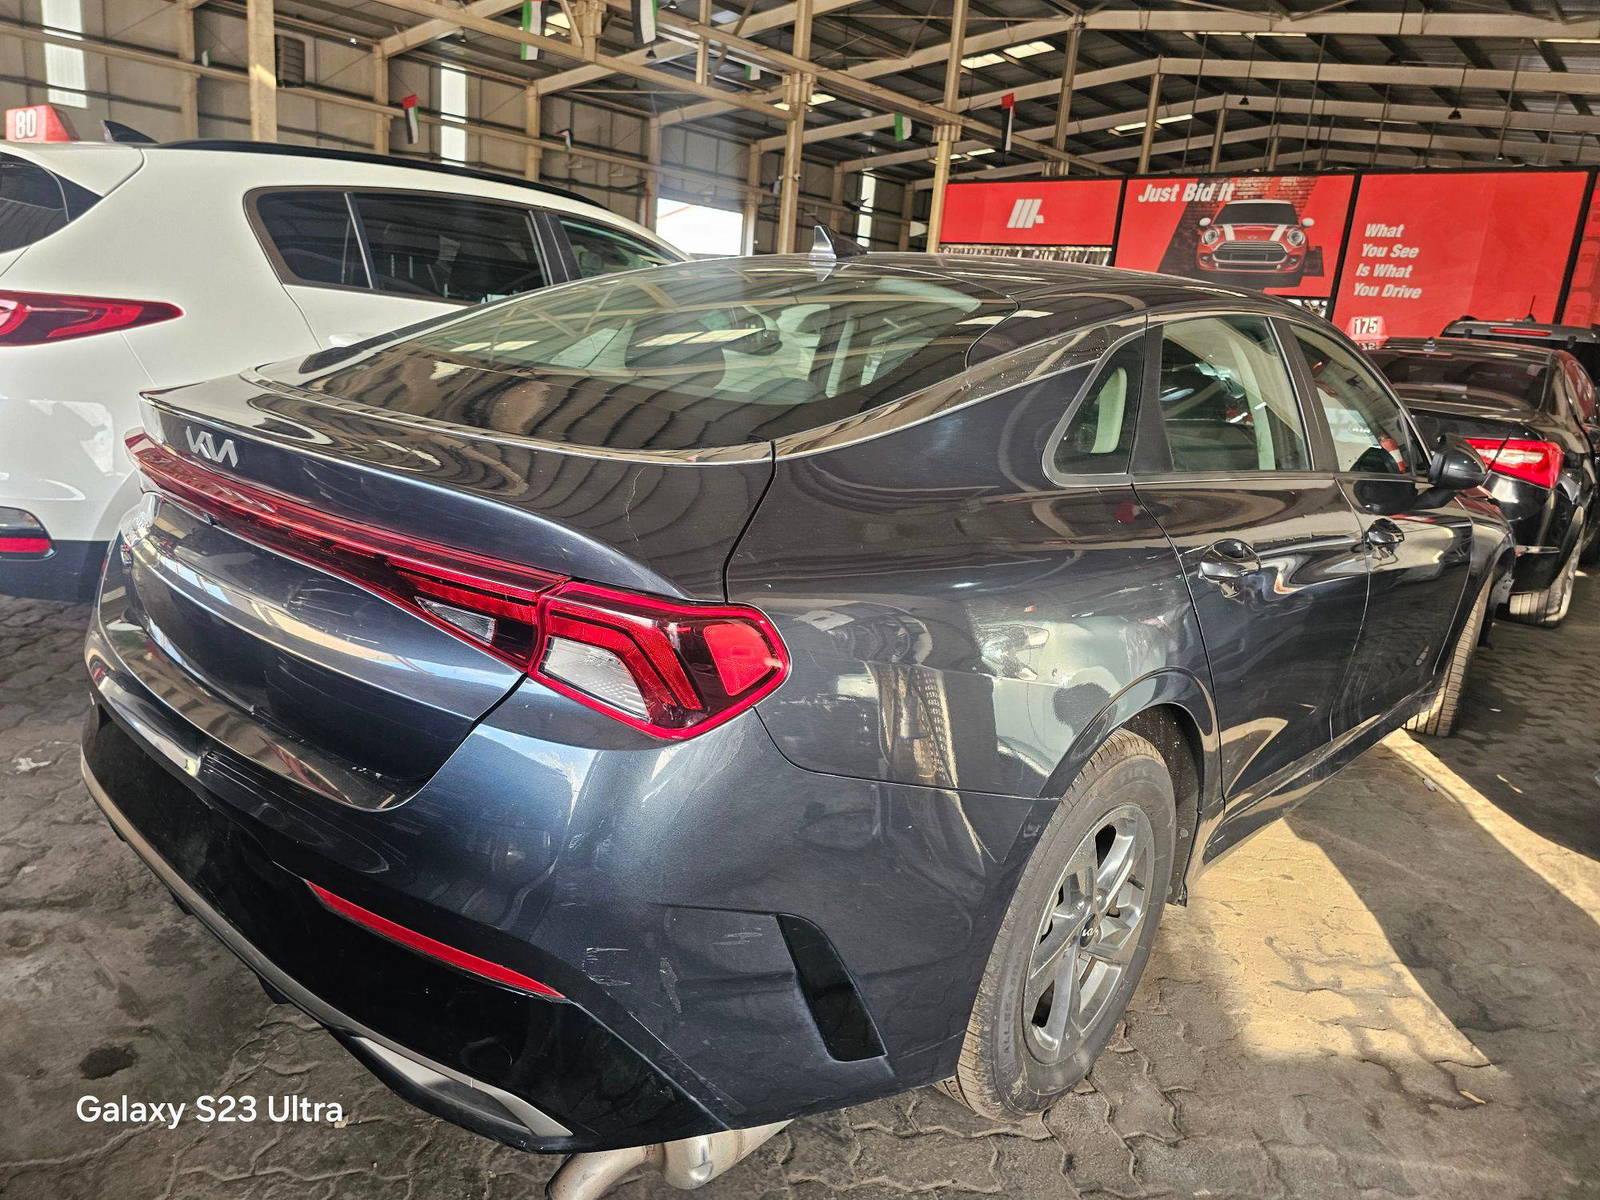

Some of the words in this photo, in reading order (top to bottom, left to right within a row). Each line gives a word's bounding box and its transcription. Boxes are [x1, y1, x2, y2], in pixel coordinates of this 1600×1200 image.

[15, 109, 37, 139] 80
[1138, 183, 1180, 202] Just
[1182, 182, 1214, 202] Bid
[1217, 183, 1234, 202] It
[1365, 223, 1404, 238] What
[1361, 243, 1388, 258] You
[1389, 244, 1420, 259] See
[1355, 263, 1371, 277] Is
[1373, 263, 1413, 278] What
[1353, 282, 1379, 297] You
[1381, 284, 1422, 299] Drive
[1354, 317, 1379, 335] 175
